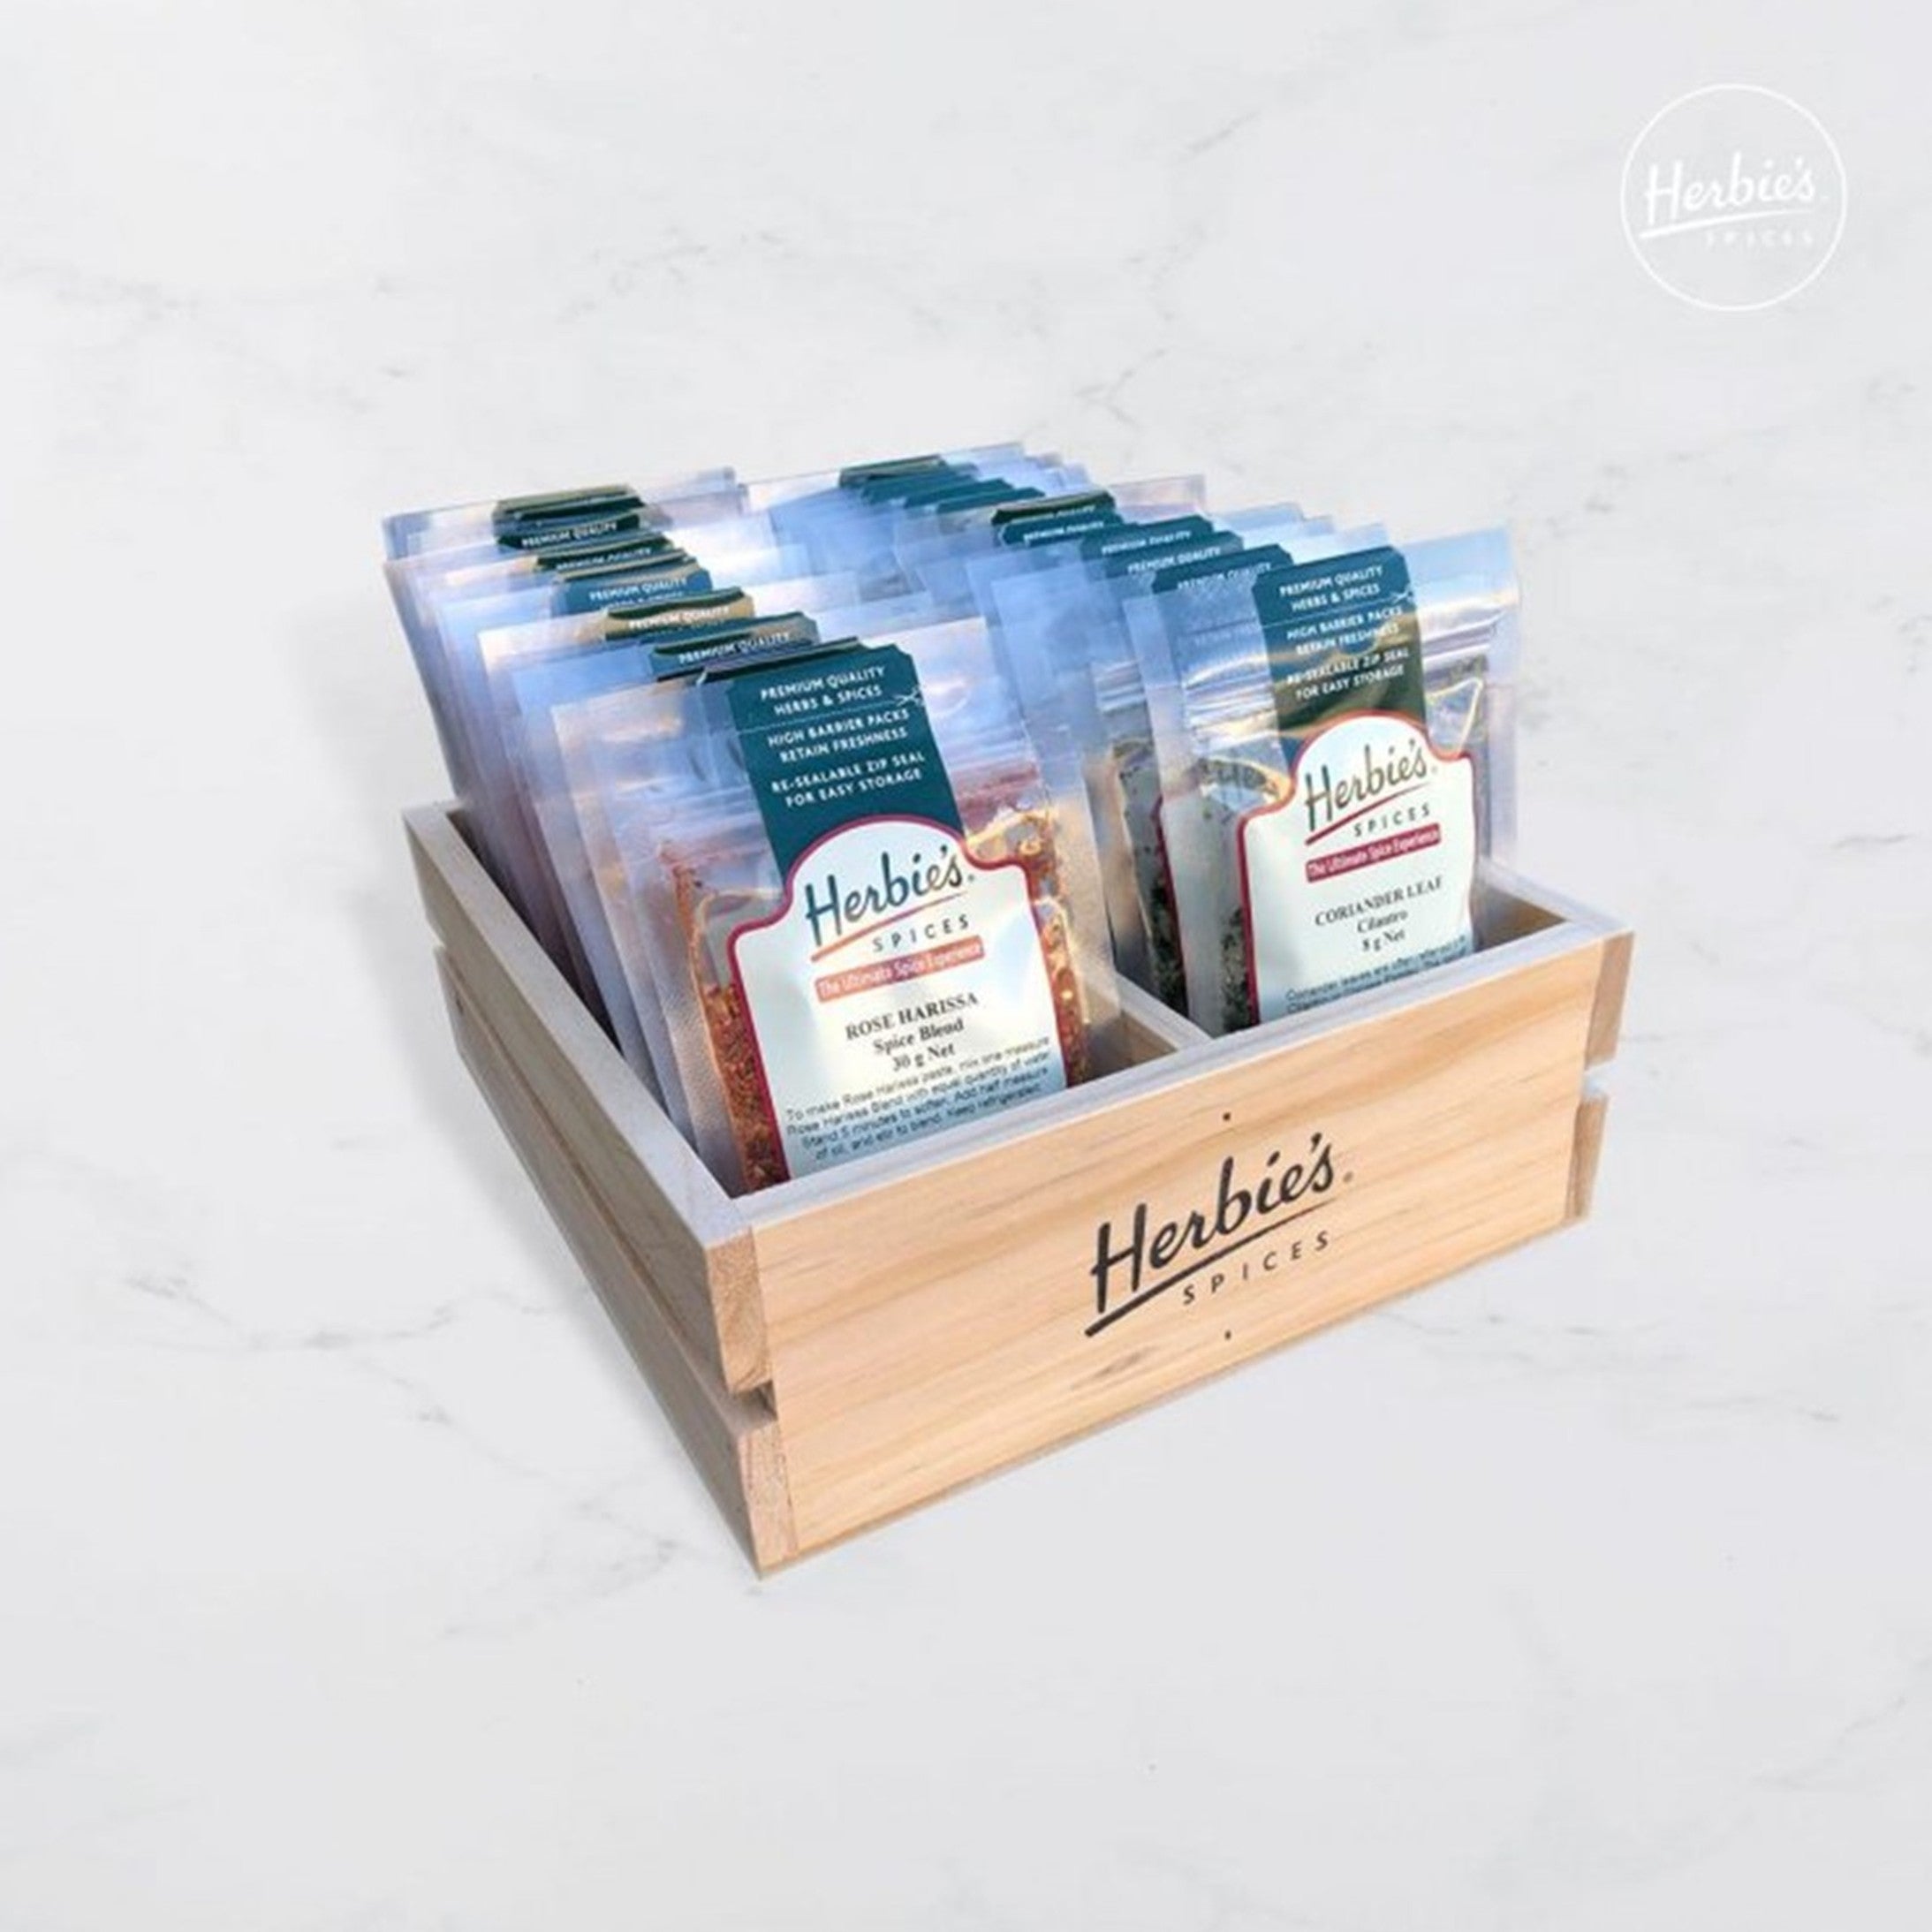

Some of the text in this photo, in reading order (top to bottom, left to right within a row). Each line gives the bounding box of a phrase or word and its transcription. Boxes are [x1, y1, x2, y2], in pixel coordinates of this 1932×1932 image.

[588, 577, 689, 602] PREMIUM QUALITY
[1279, 564, 1384, 598] PREMIUM QUALITY
[1291, 582, 1381, 612] HERBS & SPICES
[1286, 605, 1404, 640] HIGH BARRIER PACKS
[678, 632, 791, 664] PREMIUM QUALITY
[1295, 637, 1337, 655] RETAIN
[1383, 646, 1411, 662] SEAL
[760, 666, 886, 701] PREMIUM QUALITY
[1296, 663, 1405, 701] FOR EASY STORAGE
[774, 684, 883, 716] HERBS & SPICES
[768, 708, 911, 748] HIGH BARRIER PACKS
[779, 726, 908, 764] RETAIN FRESHNESS
[770, 750, 926, 793] RE-SEALABLE ZIP SEAL
[784, 767, 923, 809] FOR EASY STORAGE
[1304, 738, 1428, 832] Herbie's
[1352, 802, 1431, 837] SPICES
[804, 843, 965, 947] Herbie's
[1315, 875, 1443, 926] CORIANDER LEAF
[871, 913, 971, 953] SPICES
[1357, 910, 1409, 934] Cilantro
[1373, 937, 1381, 951] g
[1383, 928, 1405, 943] Net
[845, 992, 979, 1041] ROSE HARISSA
[873, 1018, 965, 1056] Spice Blend
[892, 1042, 955, 1072] 30 g Net
[786, 1109, 804, 1121] To
[805, 1101, 840, 1116] make
[842, 1090, 874, 1103] Rose
[786, 1121, 820, 1135] Rose
[1089, 1132, 1336, 1315] Herbie's
[1182, 1230, 1330, 1306] SPICES
